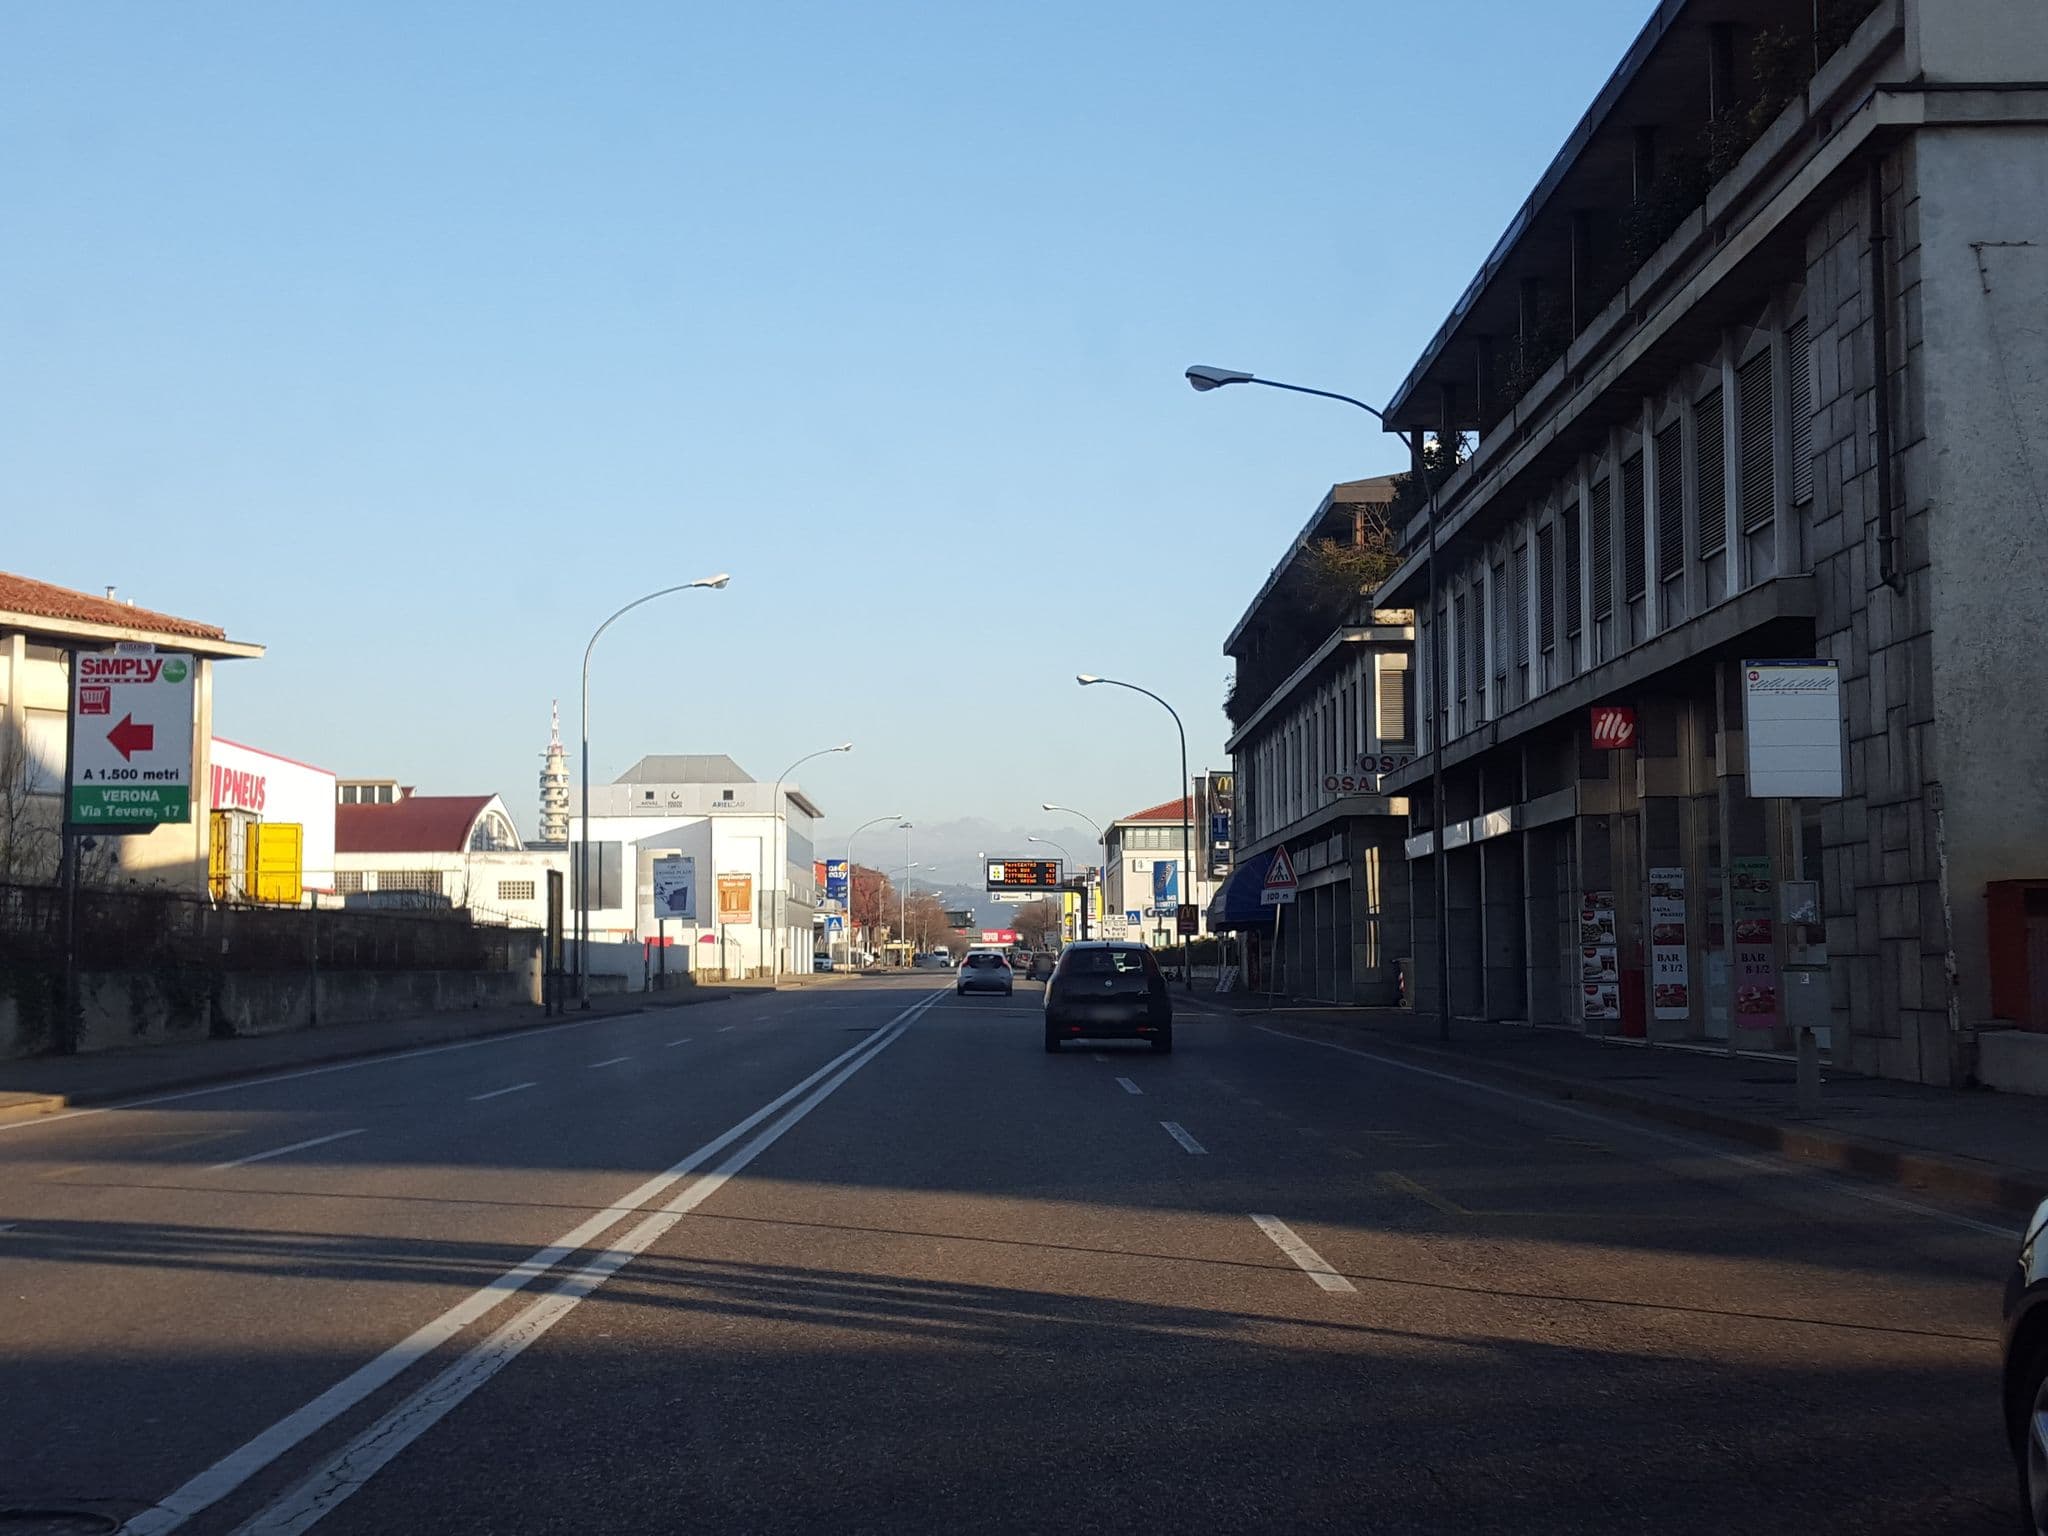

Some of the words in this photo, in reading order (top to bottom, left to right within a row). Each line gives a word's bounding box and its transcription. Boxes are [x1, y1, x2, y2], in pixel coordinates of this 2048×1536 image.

[1595, 713, 1633, 745] illy
[84, 769, 94, 780] A
[99, 769, 138, 780] 1.500
[143, 768, 180, 780] metri
[222, 767, 266, 811] PNEUS
[102, 790, 160, 802] VERONA
[80, 805, 102, 817] Via
[107, 805, 158, 819] Tevere,
[164, 805, 180, 817] 17
[828, 871, 847, 880] easy
[1657, 953, 1680, 962] BAR
[1741, 953, 1766, 962] BAR
[1661, 964, 1669, 973] 8
[1671, 964, 1684, 973] 1/2
[1745, 965, 1752, 974] 8
